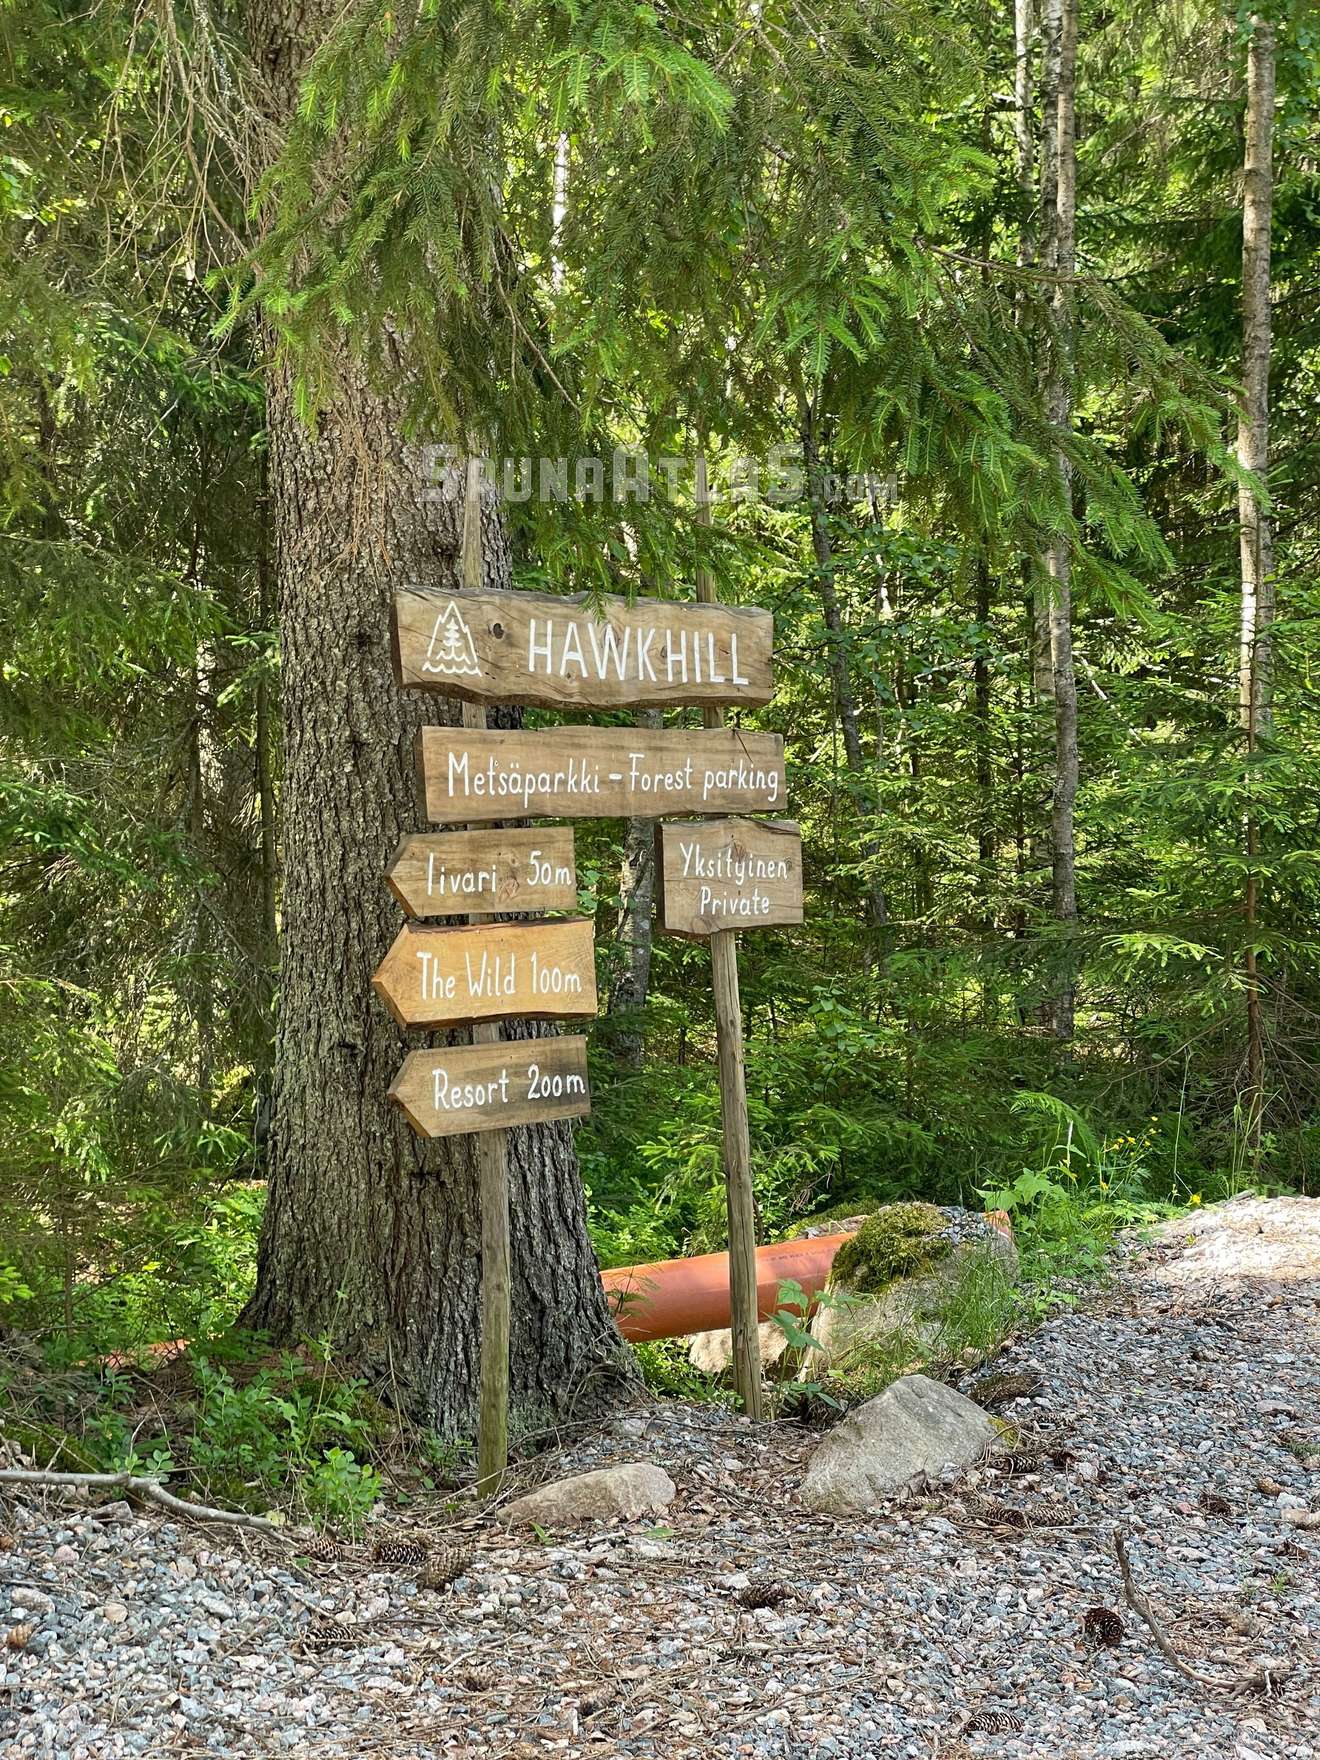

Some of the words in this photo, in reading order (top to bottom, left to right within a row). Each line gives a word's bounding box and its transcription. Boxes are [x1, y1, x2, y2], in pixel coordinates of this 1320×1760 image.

[528, 618, 750, 685] HAWKHILL
[447, 751, 600, 808] Metsäparkki
[628, 752, 693, 793] Forest
[703, 760, 779, 801] parking
[427, 852, 497, 896] Iivari
[526, 850, 572, 887] 50m
[679, 842, 788, 885] Yksityinen
[700, 885, 770, 916] Private
[416, 951, 456, 1000] The
[464, 951, 516, 997] Wild
[530, 951, 582, 994] 100m
[432, 1067, 510, 1110] Resort
[527, 1063, 586, 1100] 200m
